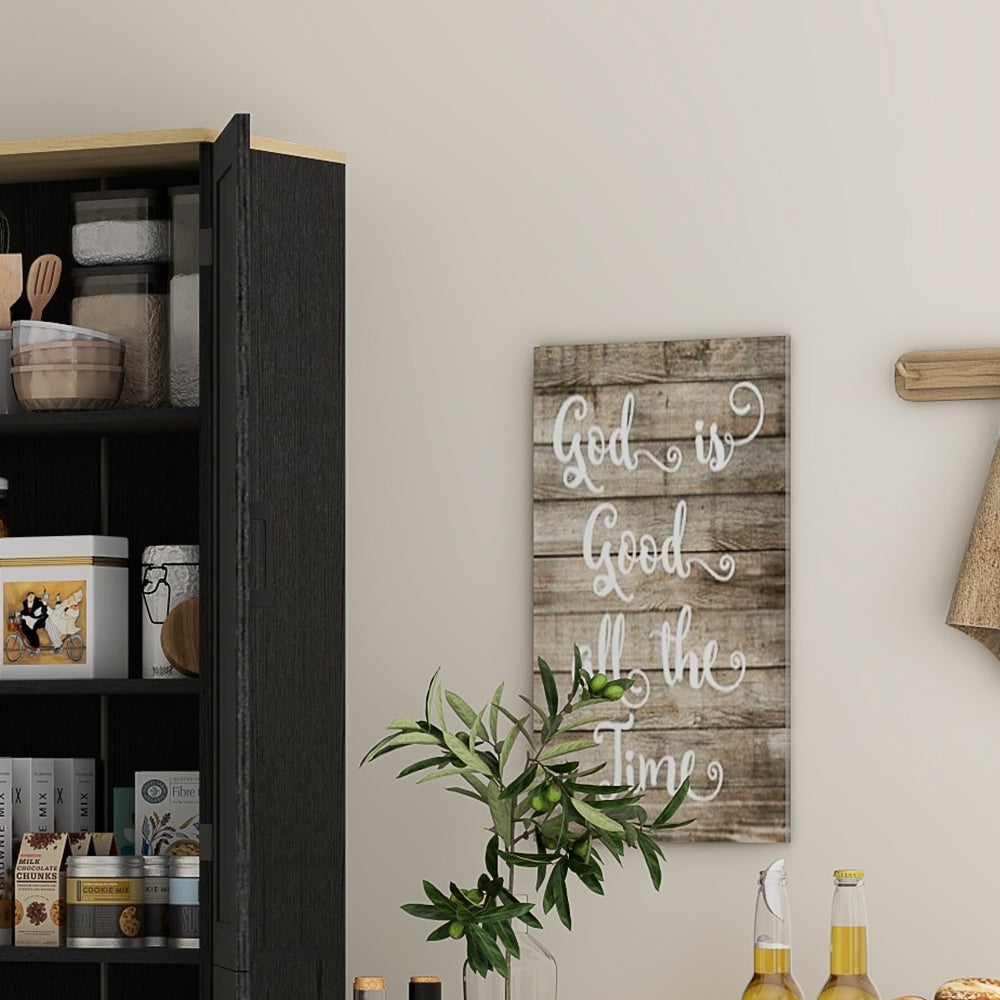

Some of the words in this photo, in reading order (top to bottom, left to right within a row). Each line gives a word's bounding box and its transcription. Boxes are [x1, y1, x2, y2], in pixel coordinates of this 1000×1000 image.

[552, 392, 682, 493] God
[694, 380, 766, 472] is
[582, 499, 736, 603] Good
[649, 603, 747, 693] the
[593, 712, 724, 802] Time
[172, 786, 195, 797] Fibre
[38, 792, 47, 817] MIX
[80, 792, 89, 817] MIX
[16, 872, 57, 880] CHUNKS
[83, 886, 113, 894] COOKIE
